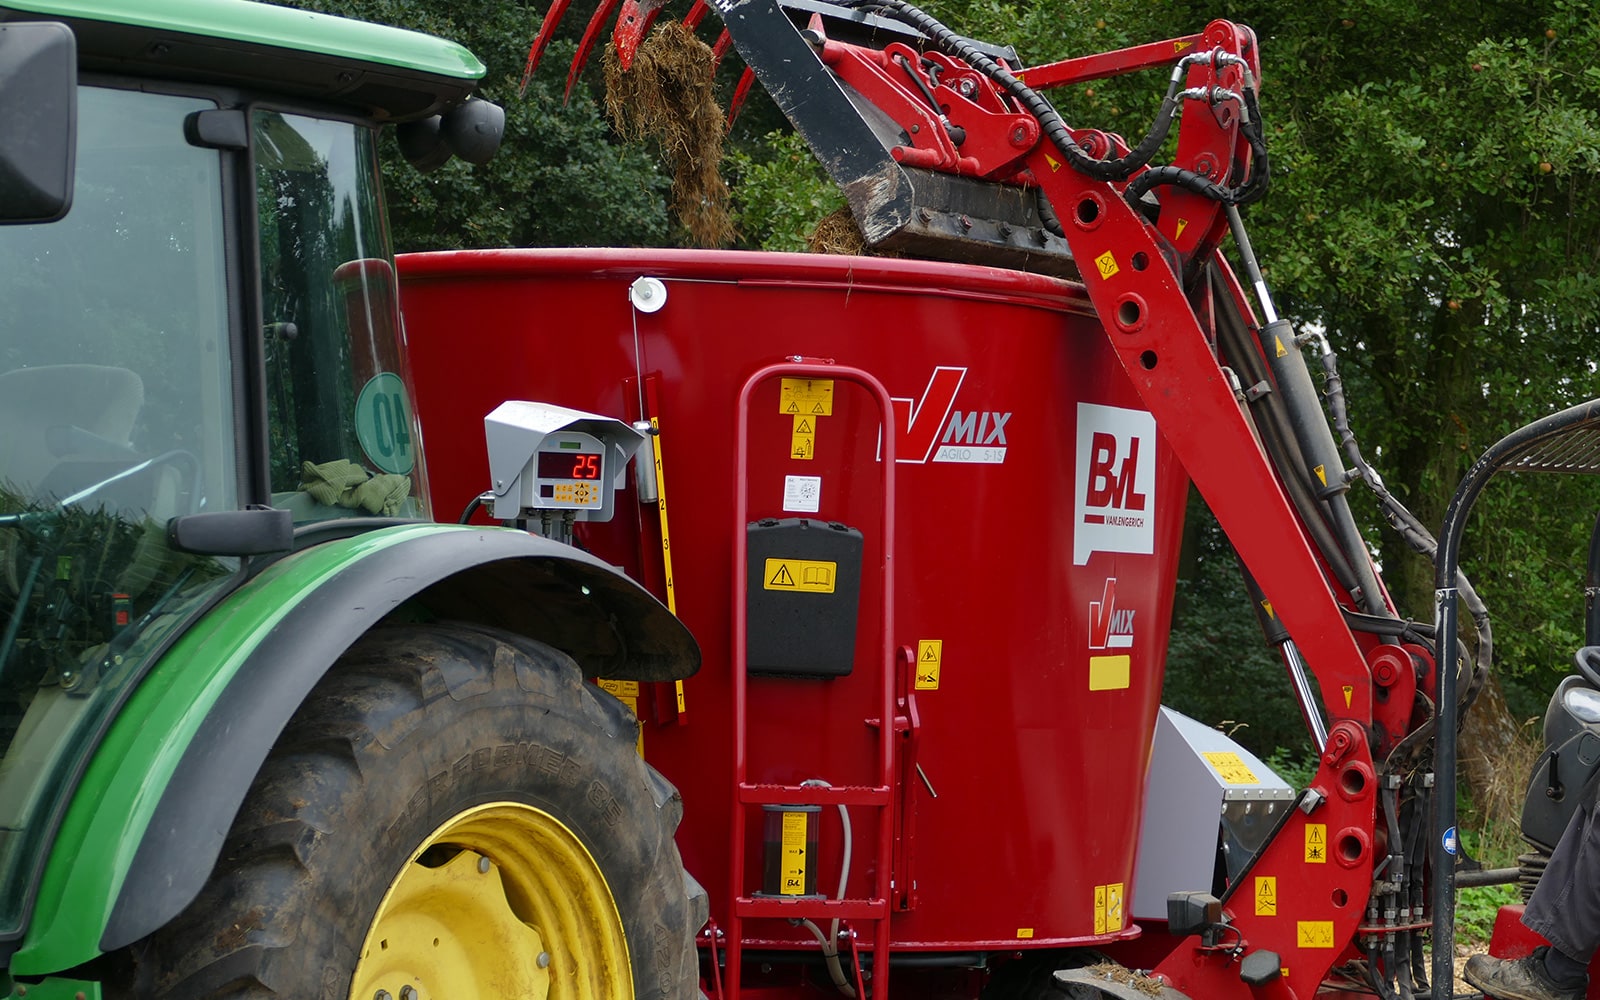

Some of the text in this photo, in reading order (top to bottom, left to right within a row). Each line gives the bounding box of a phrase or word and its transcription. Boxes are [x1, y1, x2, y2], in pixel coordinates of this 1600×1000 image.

[941, 410, 1012, 445] MIX
[940, 448, 972, 461] AGILO
[573, 455, 598, 478] 25
[656, 459, 662, 470] 1
[660, 499, 665, 510] 2
[664, 538, 669, 550] 3
[667, 578, 673, 589] 4
[678, 693, 683, 705] 7
[587, 778, 623, 827] 85
